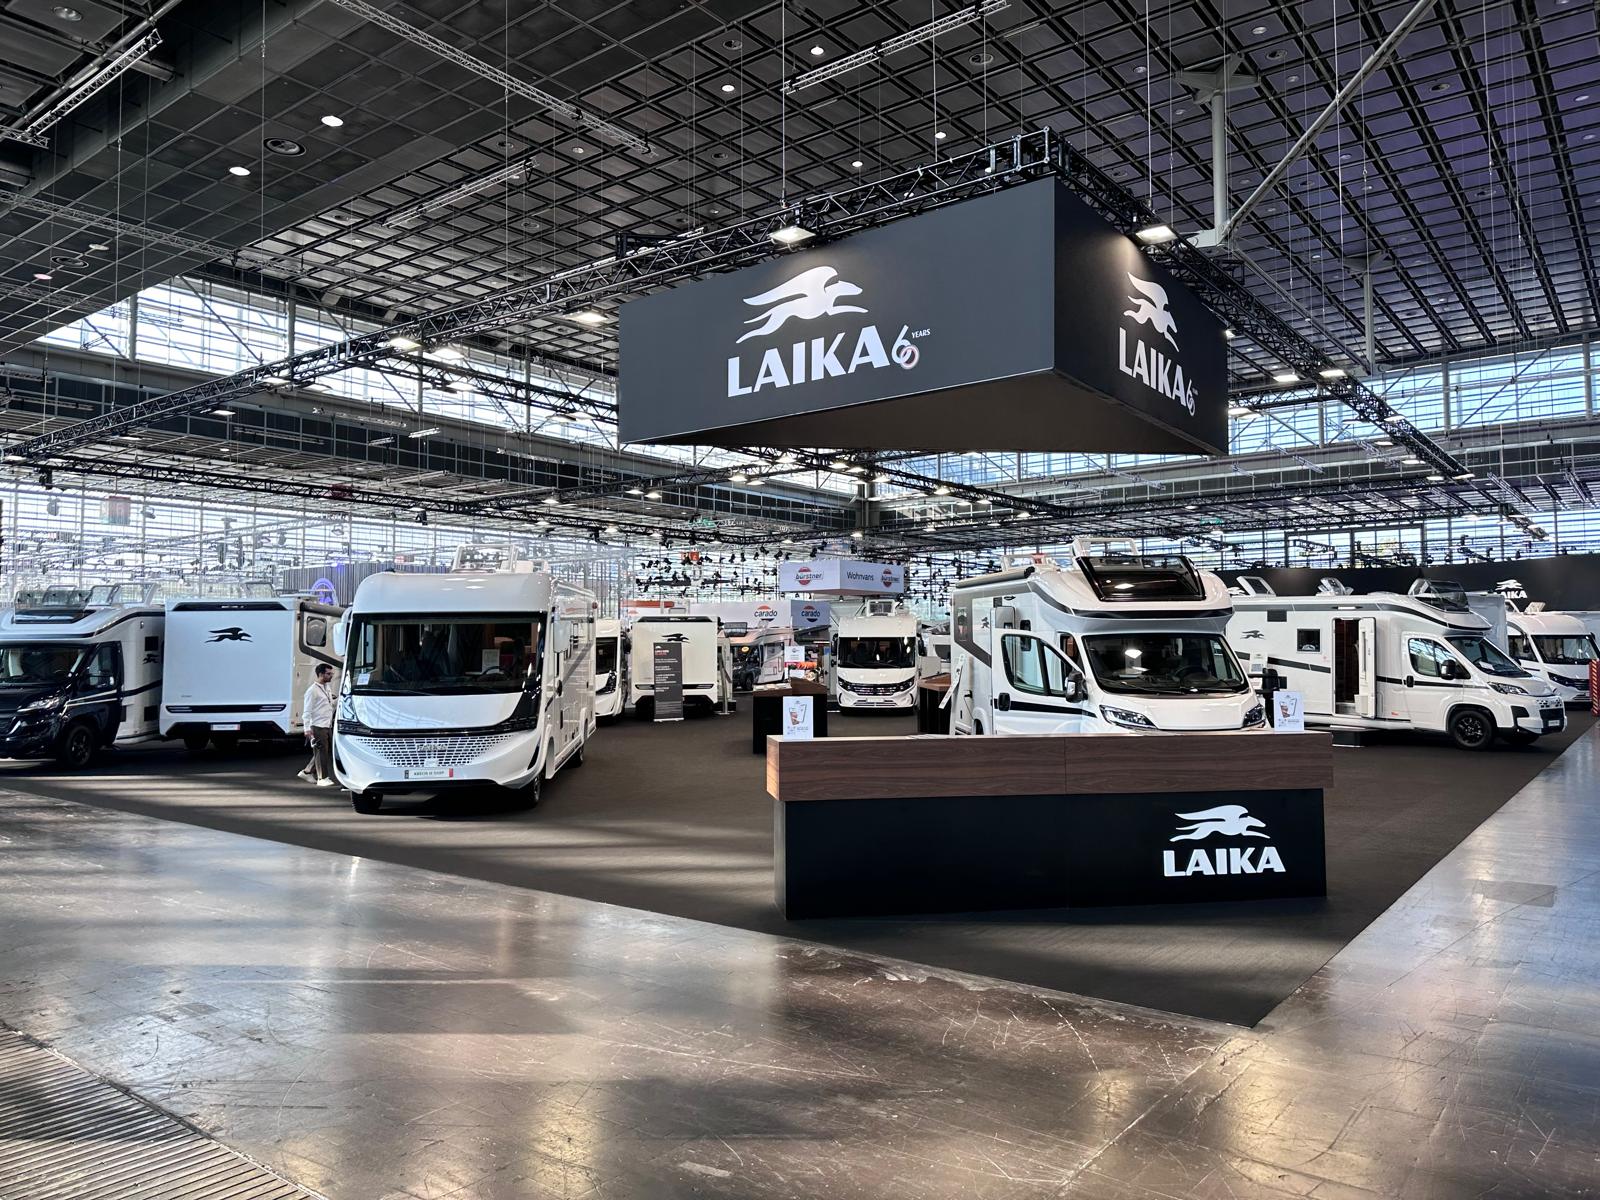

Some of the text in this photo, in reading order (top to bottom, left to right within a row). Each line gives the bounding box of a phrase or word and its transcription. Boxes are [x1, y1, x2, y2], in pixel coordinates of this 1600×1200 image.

[728, 326, 890, 397] LAIKA
[911, 329, 931, 338] YEARS
[1120, 327, 1186, 406] LAIKA
[847, 571, 874, 581] Wohnvans
[1493, 590, 1528, 599] AIKA
[754, 610, 778, 618] carado
[1163, 846, 1286, 877] LAIKA
